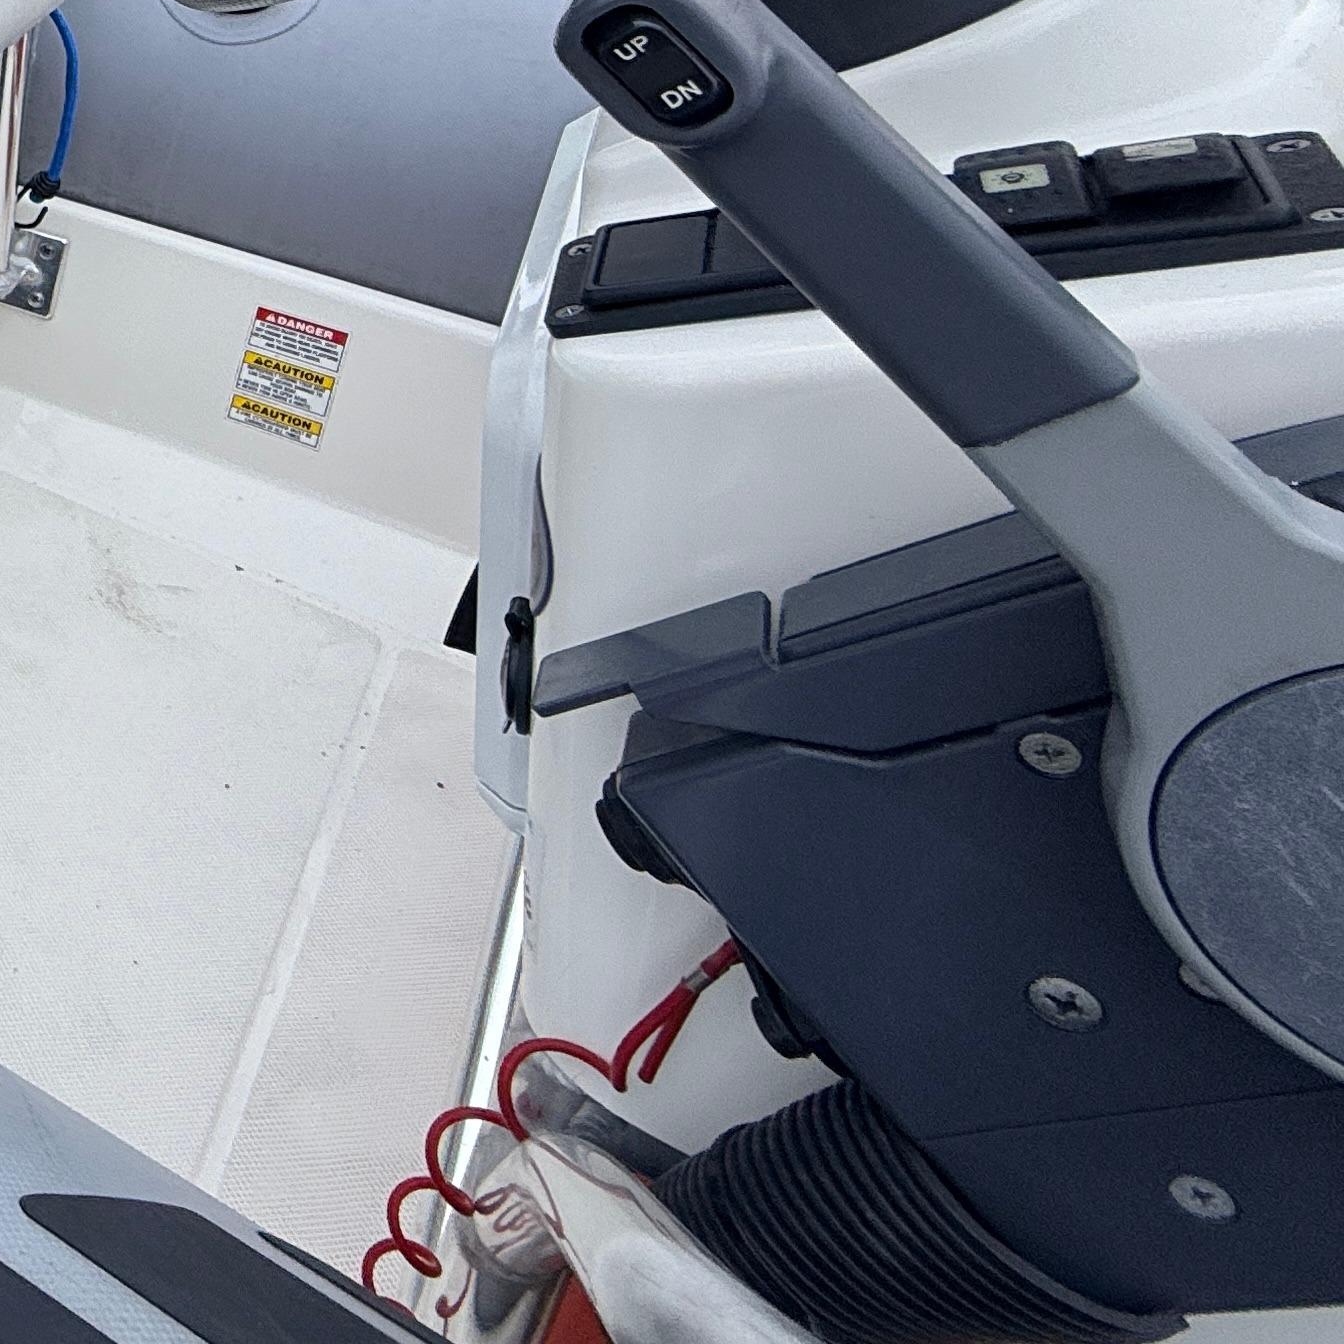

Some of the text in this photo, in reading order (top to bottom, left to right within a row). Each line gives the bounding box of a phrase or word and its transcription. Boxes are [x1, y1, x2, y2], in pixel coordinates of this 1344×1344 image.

[613, 35, 650, 61] UP
[660, 79, 704, 110] DN
[276, 315, 334, 340] DANGER
[262, 357, 325, 386] CAUTION
[251, 403, 313, 431] CAUTION
